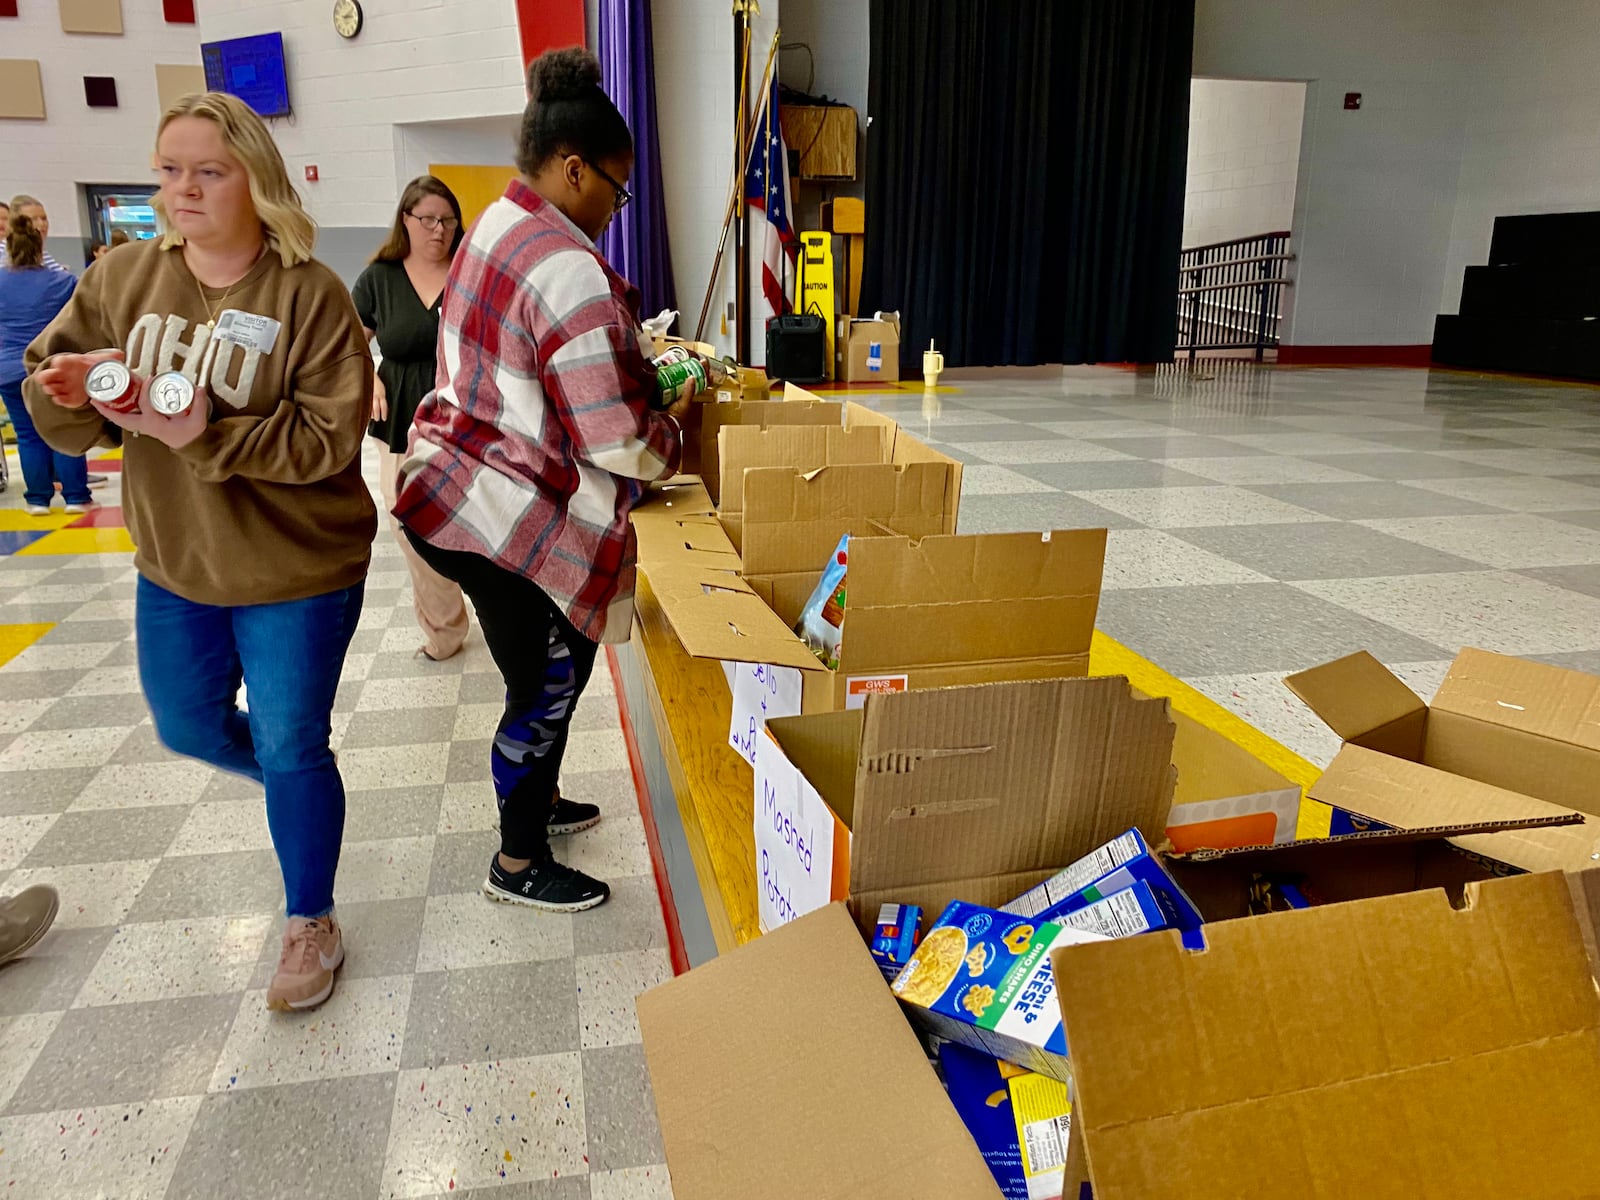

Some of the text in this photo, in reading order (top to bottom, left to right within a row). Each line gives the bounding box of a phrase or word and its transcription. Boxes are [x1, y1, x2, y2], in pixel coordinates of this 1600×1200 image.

[865, 680, 891, 689] GWS
[764, 778, 814, 878] Mashed
[1024, 942, 1045, 966] DINO
[998, 966, 1027, 1004] SHAPES
[1014, 957, 1053, 1013] HEESE
[1024, 1012, 1038, 1024] &
